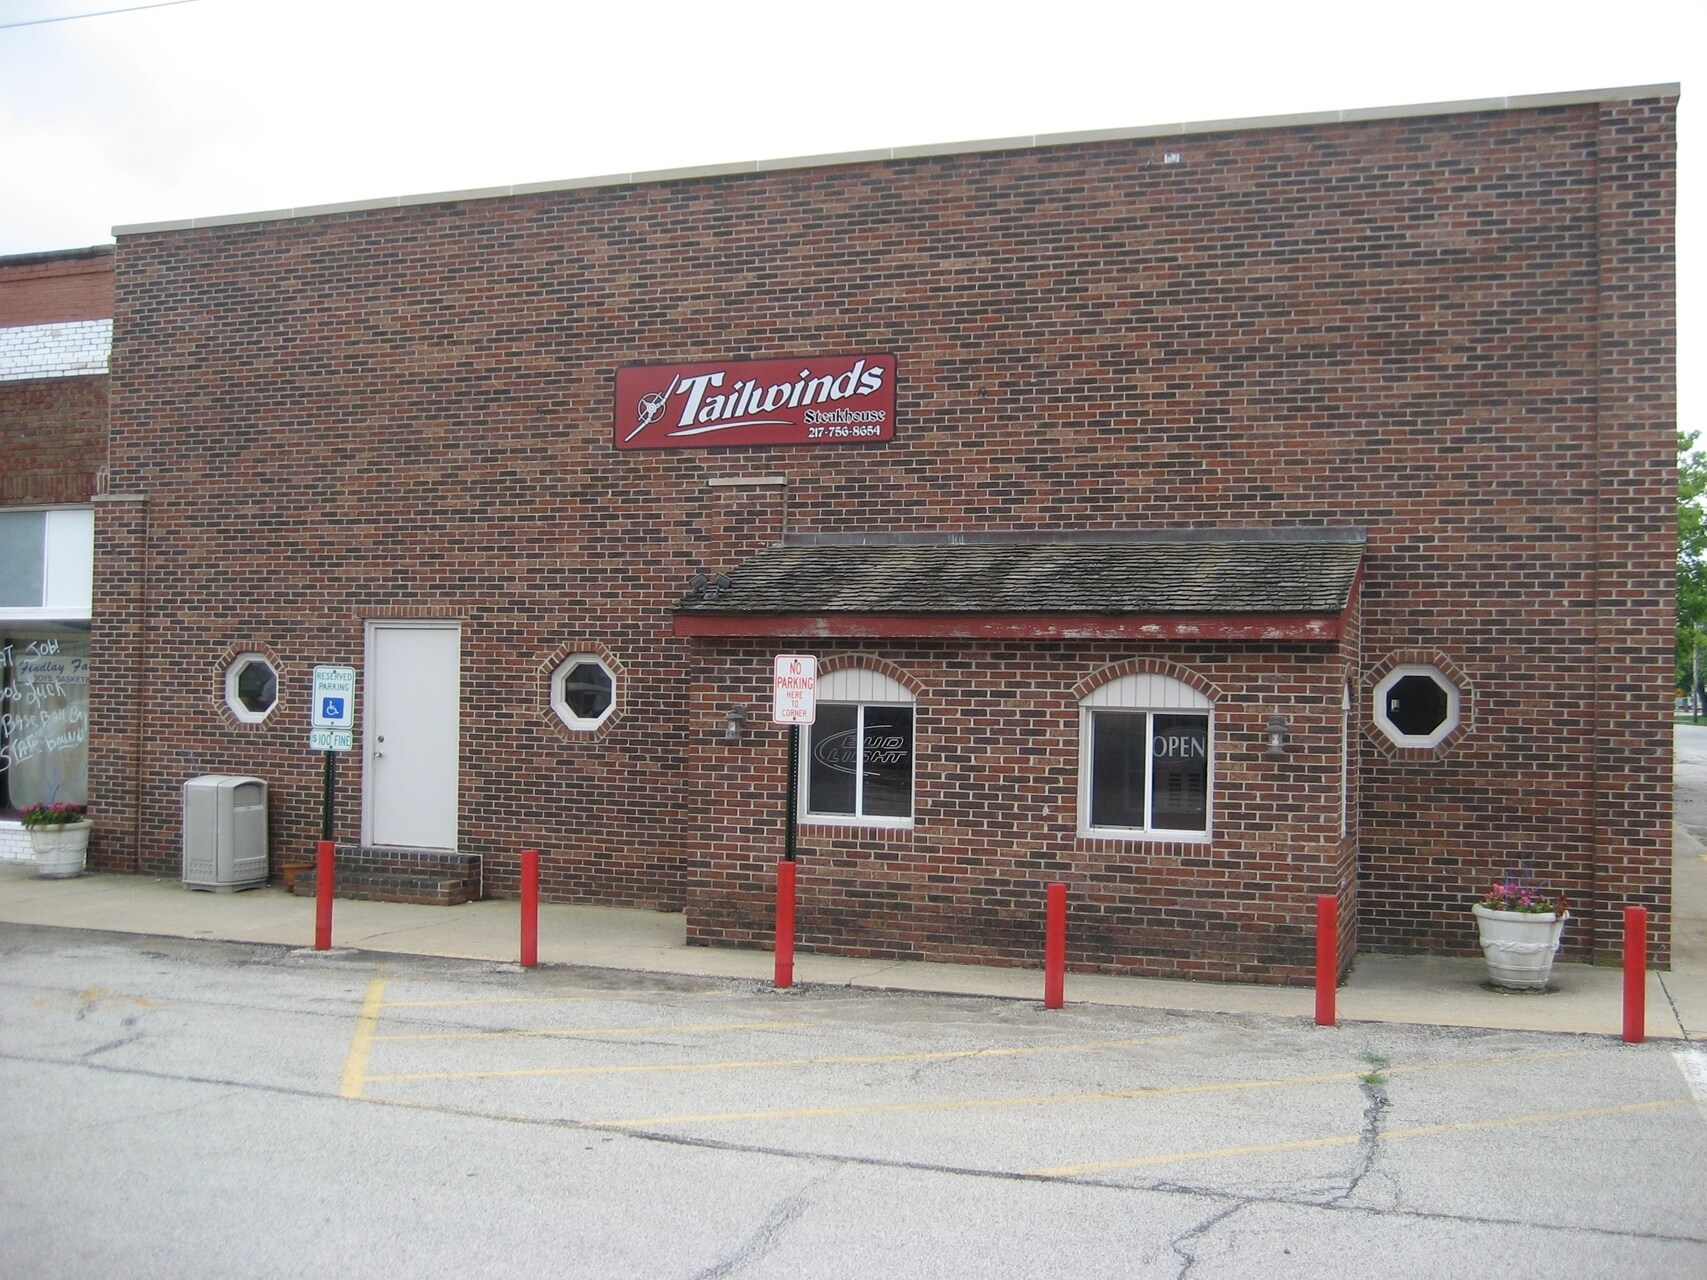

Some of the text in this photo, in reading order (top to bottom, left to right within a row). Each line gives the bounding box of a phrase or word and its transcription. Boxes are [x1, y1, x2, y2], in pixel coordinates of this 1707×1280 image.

[675, 357, 885, 427] Tailwinds
[804, 408, 886, 425] Steakhouse
[808, 425, 881, 438] 217-756-8654
[789, 662, 802, 675] NO
[316, 671, 353, 681] RESERVED
[318, 682, 350, 692] PARKING
[777, 676, 814, 690] PARKING
[786, 691, 803, 700] HERE
[791, 700, 799, 708] TO
[781, 709, 807, 717] CORNER
[311, 734, 351, 747] $100 FINE
[841, 735, 904, 750] BUD
[1153, 735, 1206, 758] OPEN
